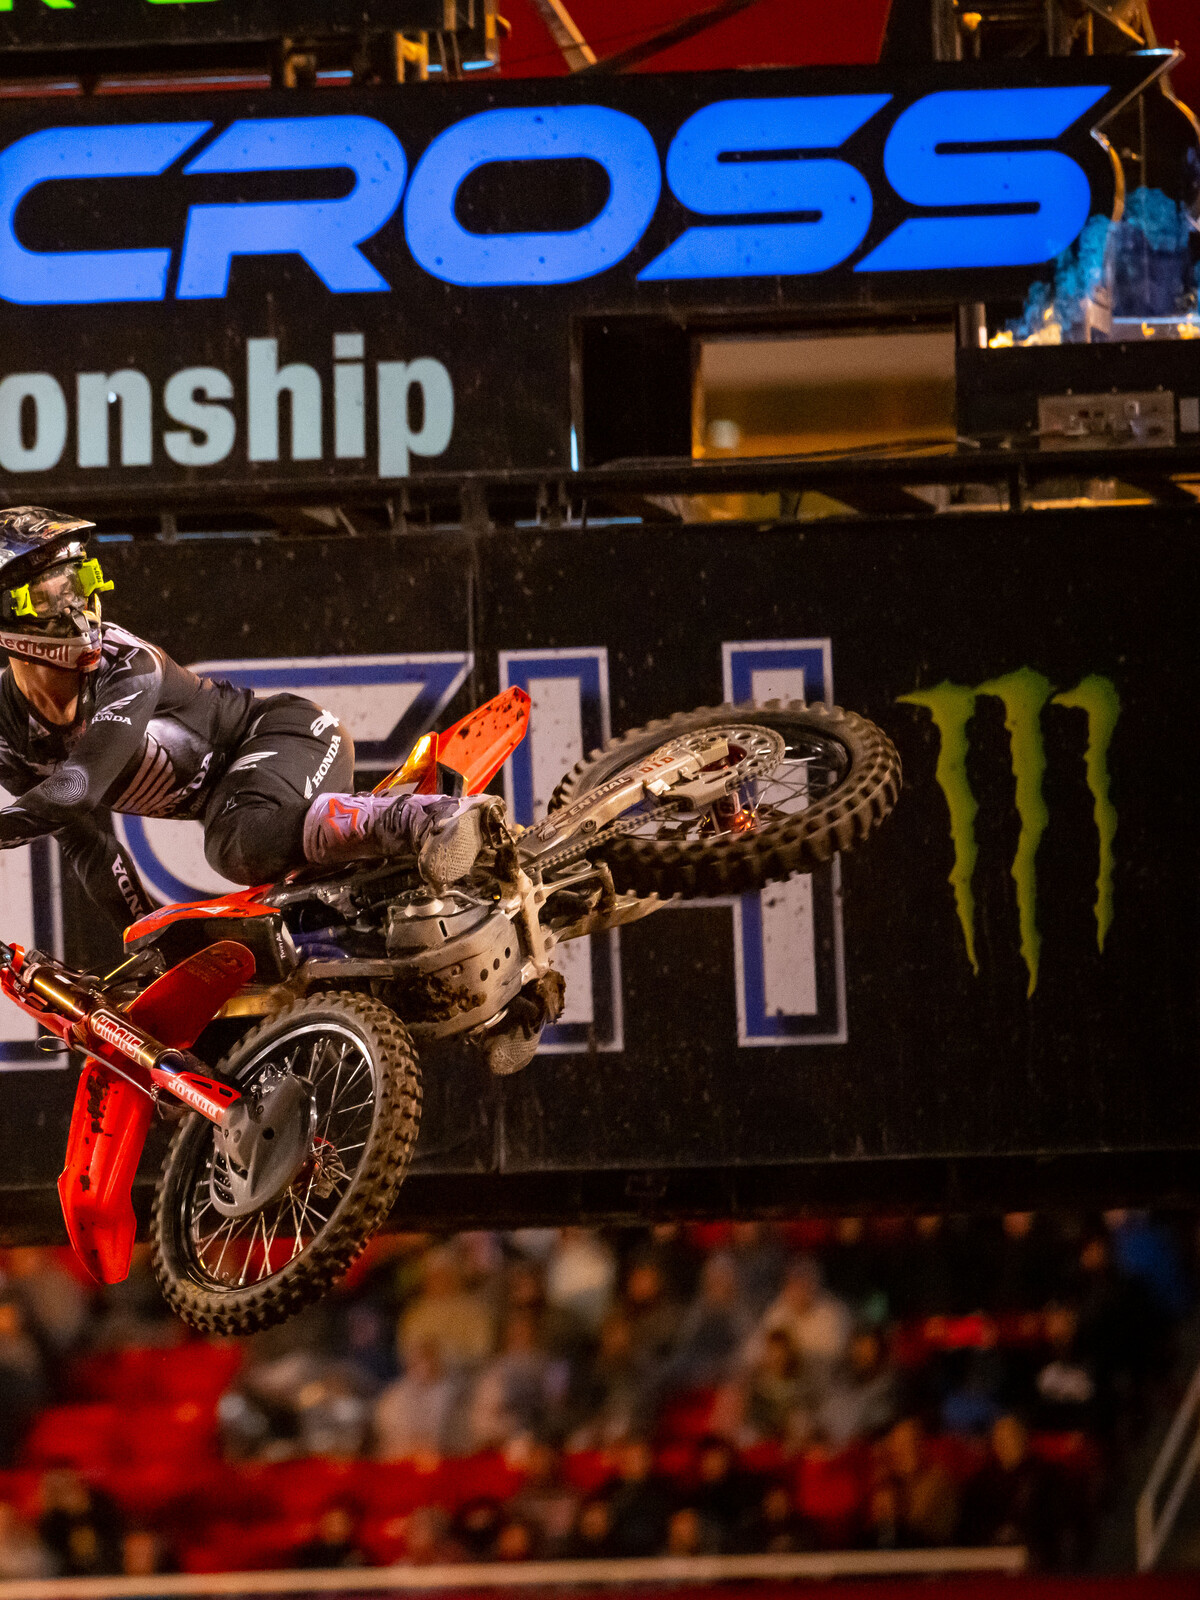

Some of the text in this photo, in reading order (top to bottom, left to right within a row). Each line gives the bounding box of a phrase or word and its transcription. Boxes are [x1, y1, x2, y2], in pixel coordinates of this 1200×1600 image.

[312, 735, 342, 788] HONDA
[639, 756, 675, 774] DID
[111, 853, 145, 920] NDA
[94, 1014, 145, 1058] SHOWA
[167, 1079, 222, 1120] DUNLOP
